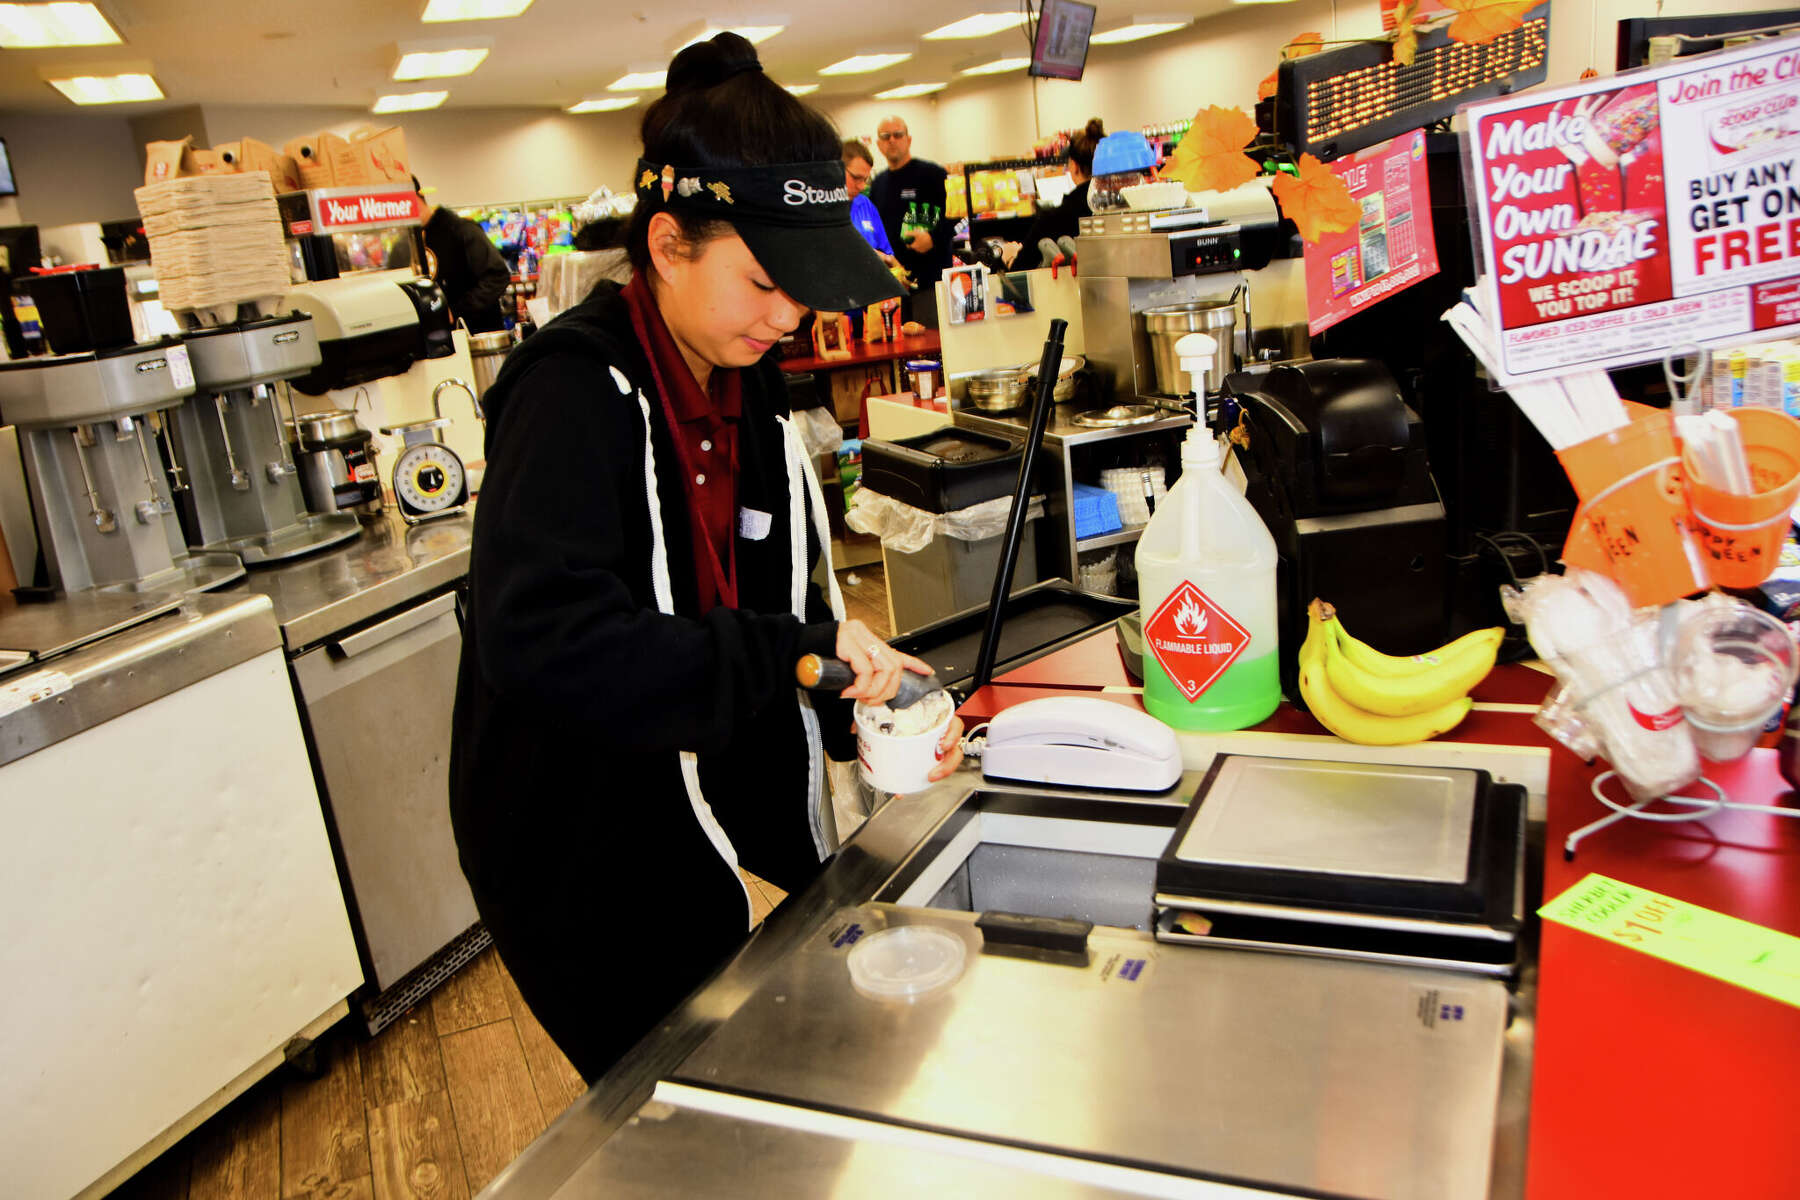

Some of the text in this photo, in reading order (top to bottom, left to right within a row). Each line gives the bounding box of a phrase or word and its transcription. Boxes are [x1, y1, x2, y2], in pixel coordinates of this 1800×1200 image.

[1668, 73, 1721, 103] Join
[1729, 65, 1768, 91] the
[1774, 52, 1800, 80] Cl
[1719, 106, 1760, 128] SCOOP
[1763, 95, 1798, 115] CLUB
[1486, 111, 1587, 160] Make
[1490, 163, 1572, 203] Your
[1689, 159, 1795, 200] BUY ANY
[327, 198, 412, 223] Your Warmer
[1494, 203, 1574, 241] Own
[1689, 195, 1749, 232] GET
[1197, 237, 1218, 247] BUNN
[1500, 219, 1659, 285] SUNDAE
[1528, 269, 1639, 303] WE SCOOP IT,
[1536, 288, 1635, 318] YOU TOP IT!
[1509, 326, 1561, 343] FLAVORED
[1589, 314, 1626, 330] COFFEE
[1672, 301, 1703, 315] BREW
[1155, 638, 1233, 655] FLAMMABLE LIQUID
[1187, 679, 1196, 692] 3
